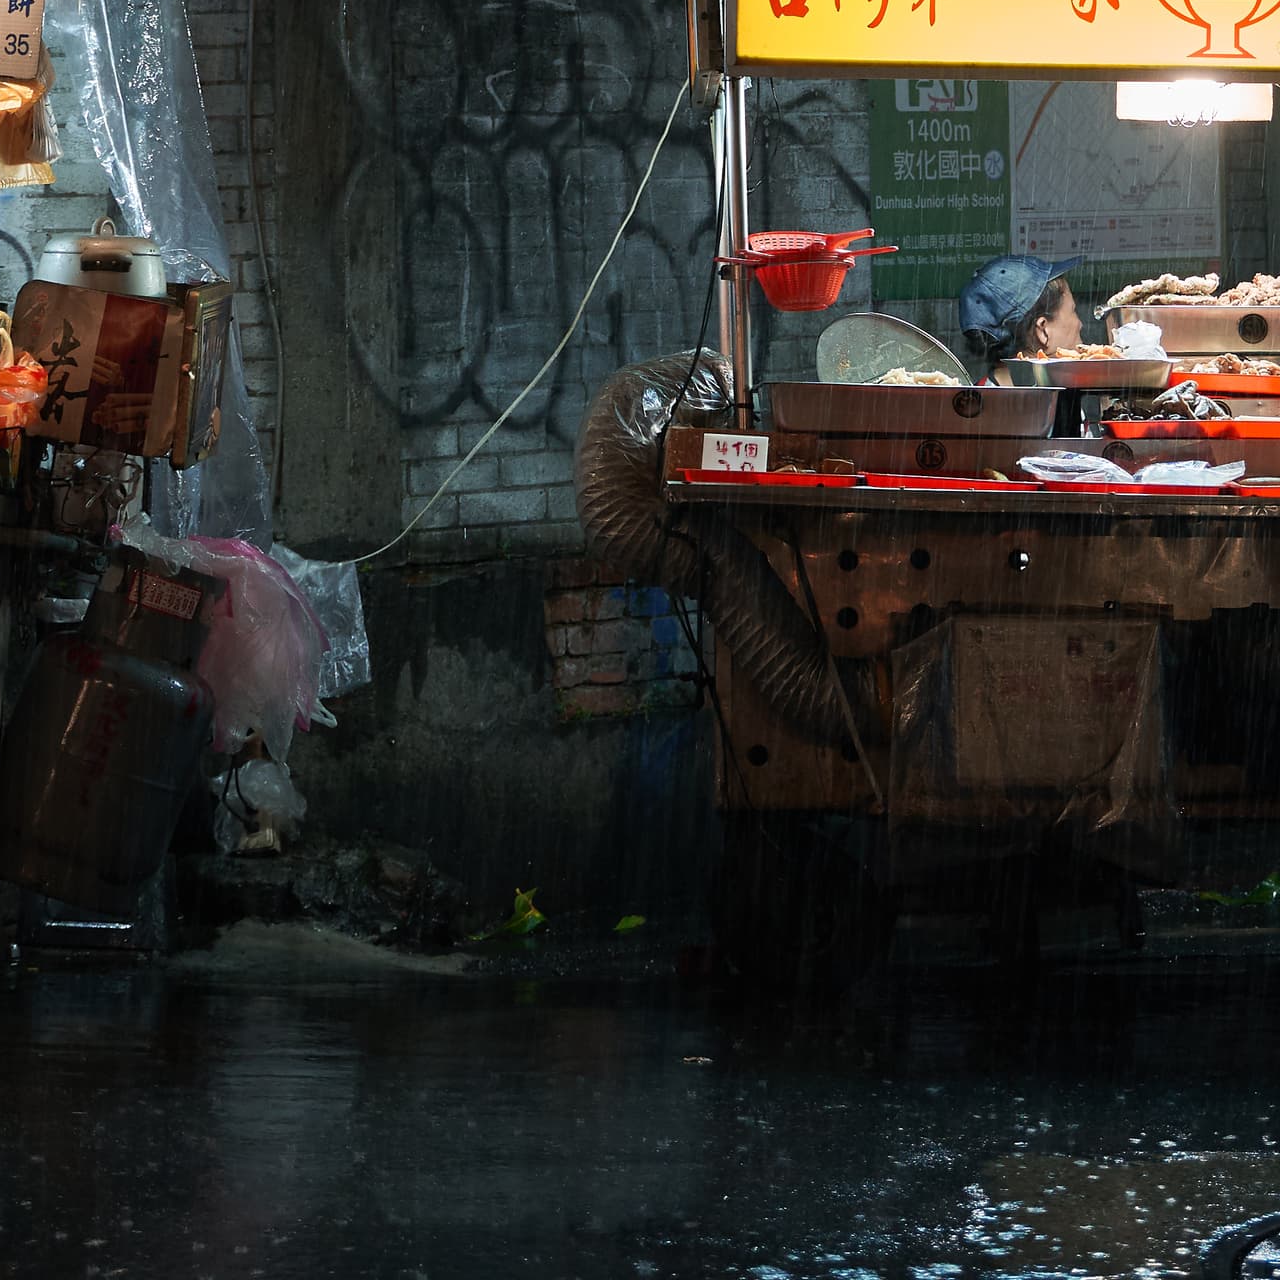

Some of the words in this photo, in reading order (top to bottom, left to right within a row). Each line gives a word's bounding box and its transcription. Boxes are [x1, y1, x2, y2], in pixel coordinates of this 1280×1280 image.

[4, 33, 30, 56] 35
[908, 119, 971, 142] 1400m
[893, 149, 981, 181] 敦化國中
[875, 195, 912, 209] Dunhua
[914, 196, 945, 209] Junior
[947, 195, 970, 211] High
[971, 194, 1004, 208] School
